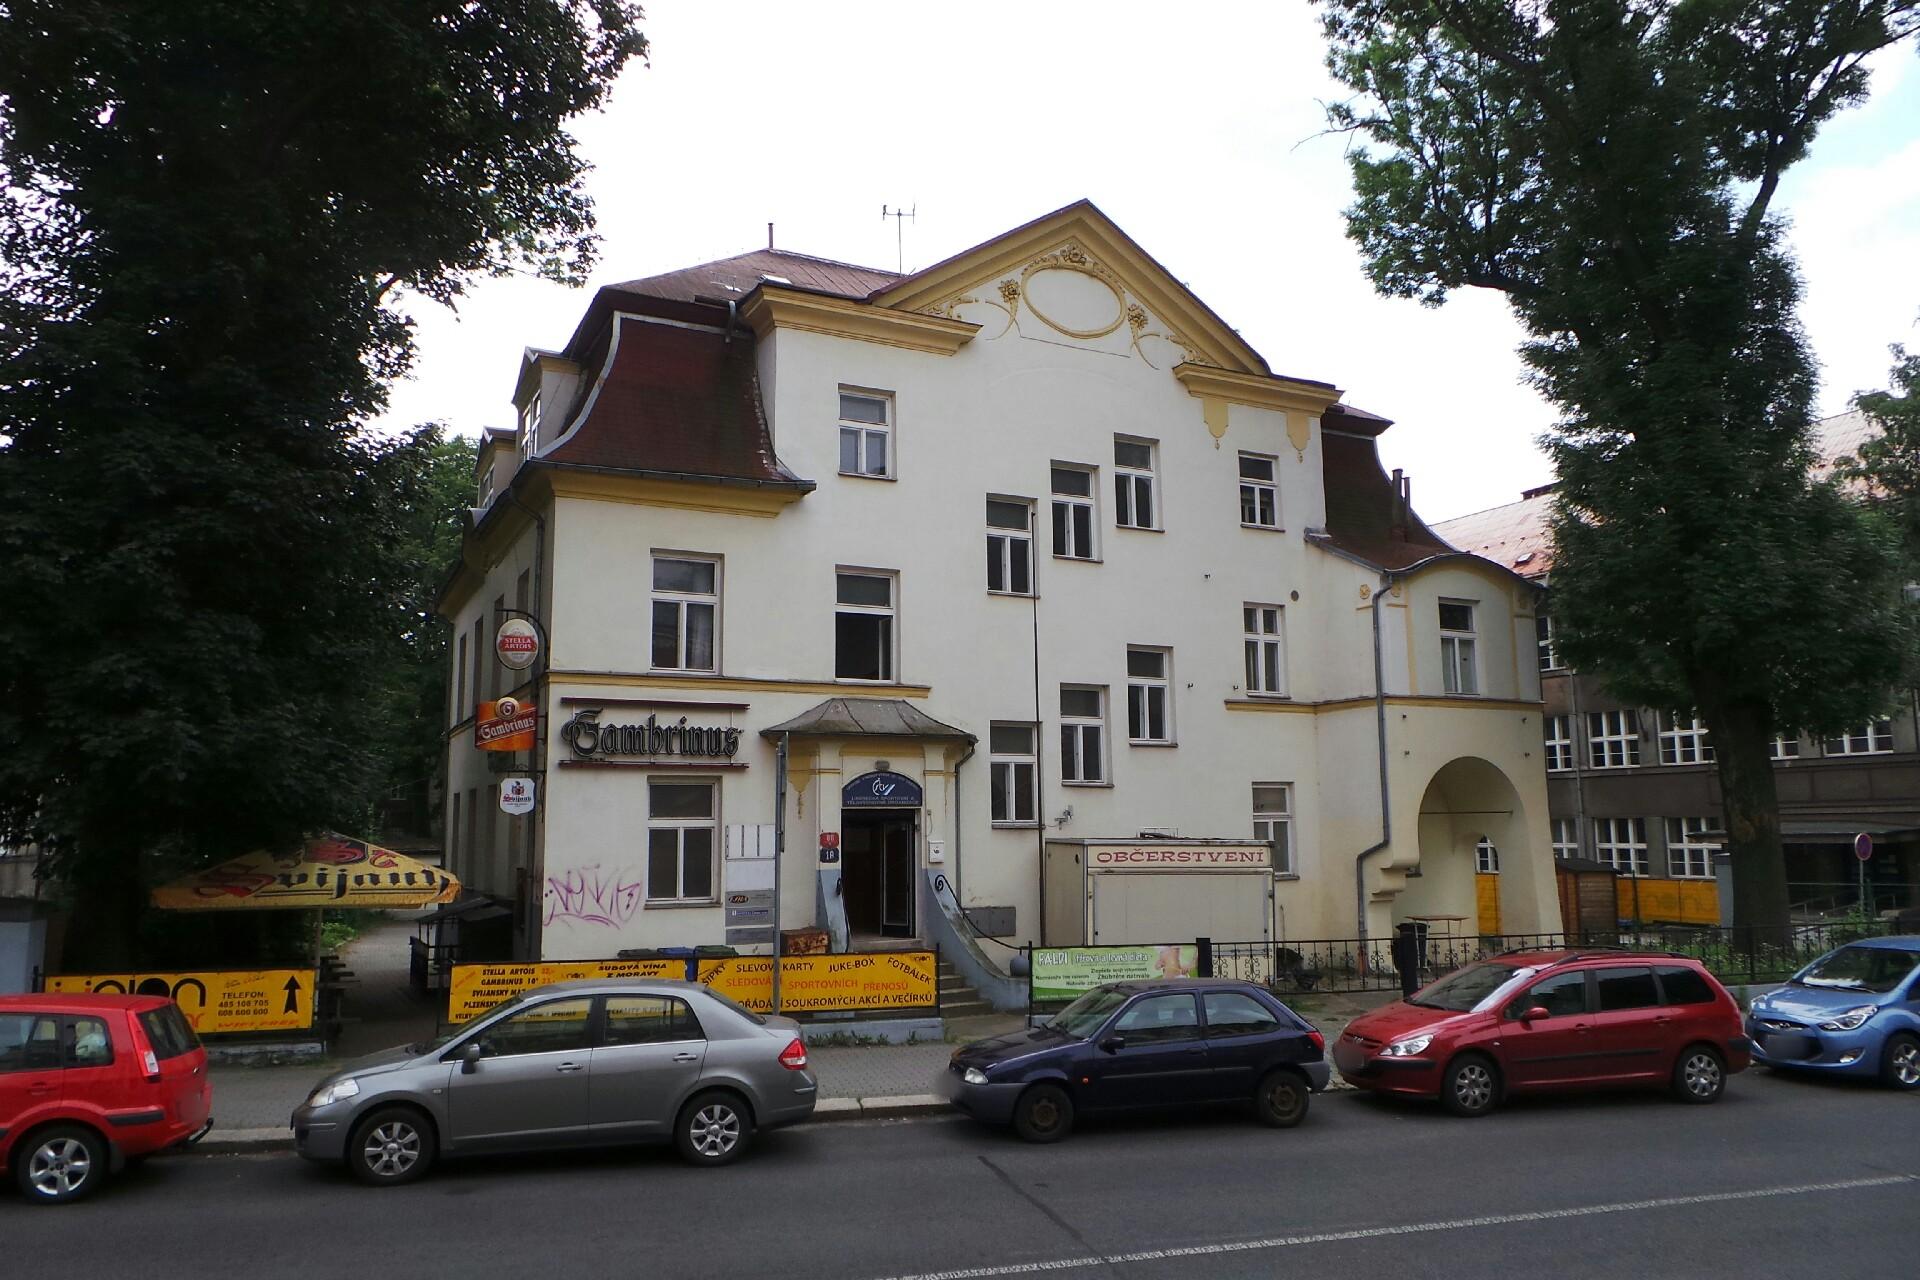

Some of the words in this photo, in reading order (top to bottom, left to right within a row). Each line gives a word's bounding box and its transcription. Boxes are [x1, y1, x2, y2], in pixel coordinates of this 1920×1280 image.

[481, 716, 535, 740] Gambrinus
[560, 707, 745, 757] Gambrinus
[1096, 848, 1264, 863] OBČERSTVENÍ
[482, 968, 506, 976] STELLA
[509, 967, 536, 975] ARTOIS
[736, 963, 775, 973] SLEVOV
[782, 962, 814, 971] KARTY
[828, 957, 875, 973] JUKE-BOX
[887, 957, 932, 985] FOTBÁLEK
[481, 977, 523, 985] GAMBRINUS
[616, 970, 660, 978] MORAVY
[726, 977, 783, 988] SLEDOVÁÍ
[788, 978, 858, 990] SPORTOVNÍCH
[737, 995, 783, 1009] OŘÁDÁÍ
[786, 994, 856, 1008] SOUKROMÝCH
[858, 993, 881, 1005] AKCÍ
[882, 995, 890, 1004] A
[892, 991, 933, 1004] VEČÍRKŮ
